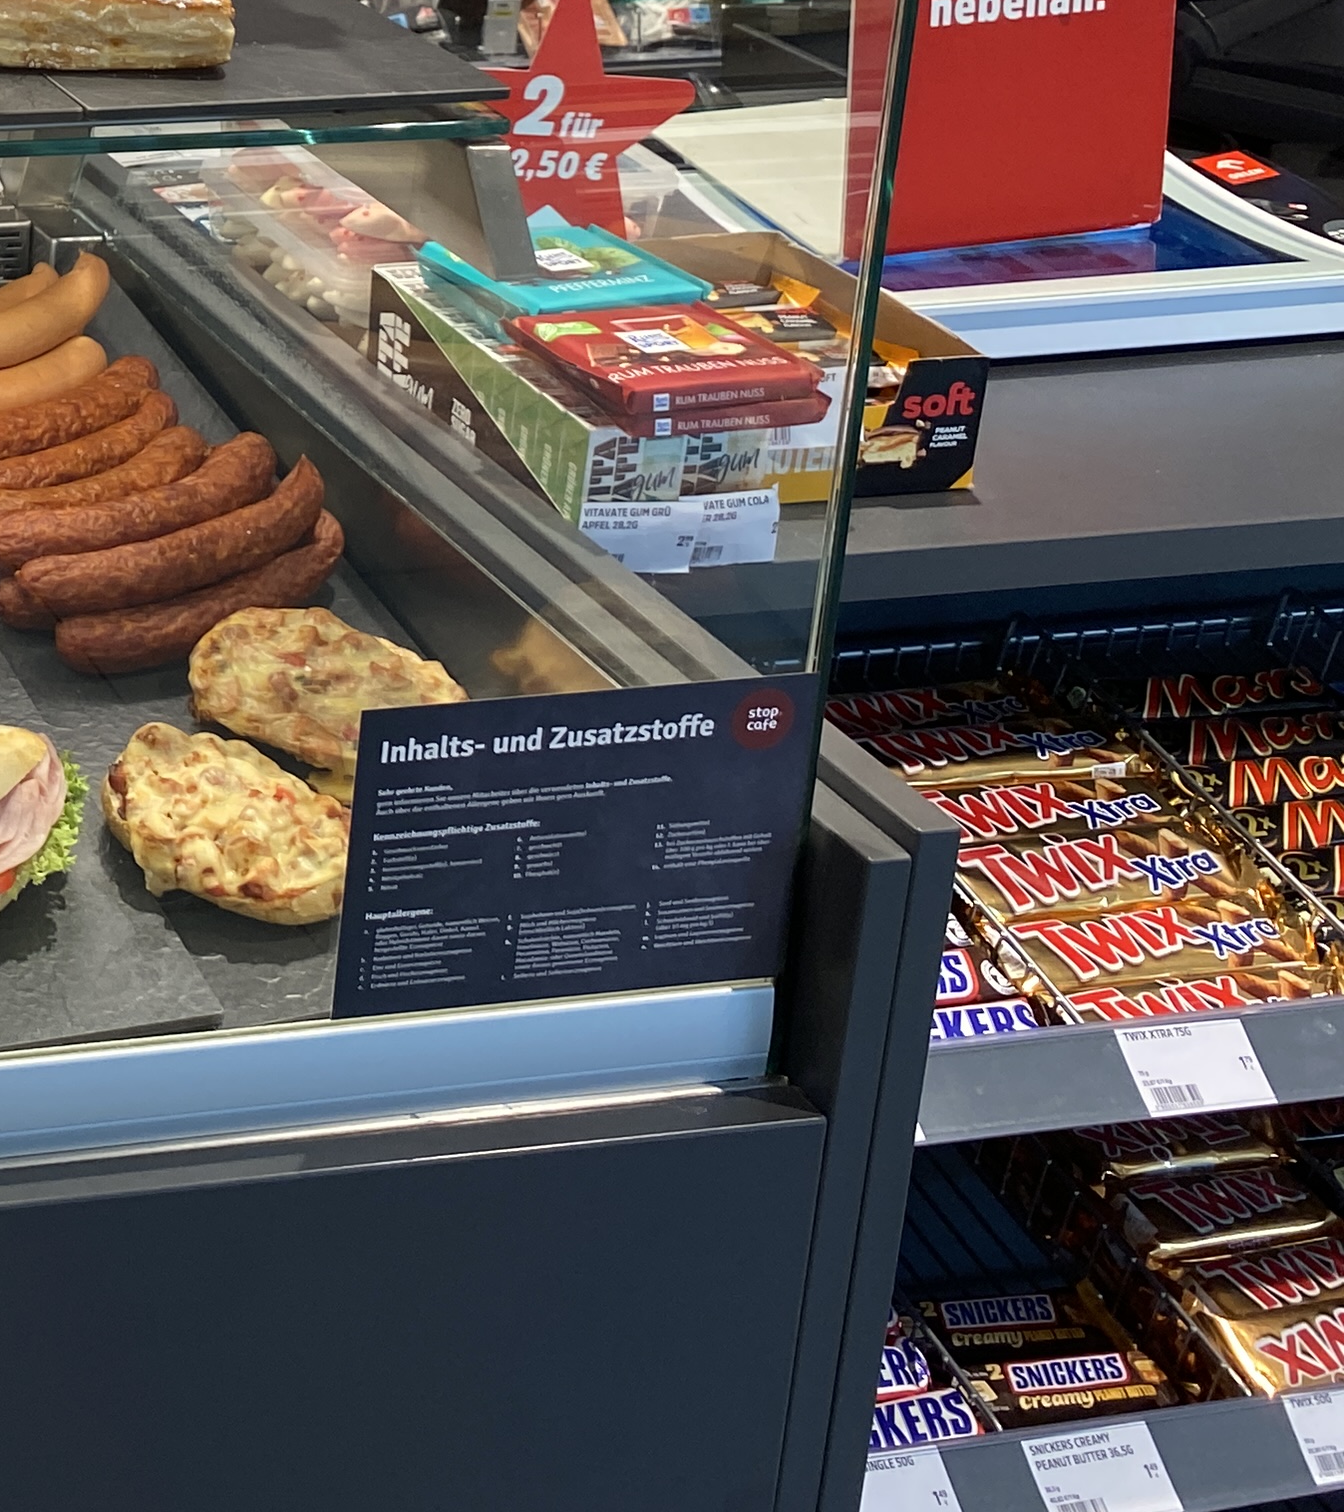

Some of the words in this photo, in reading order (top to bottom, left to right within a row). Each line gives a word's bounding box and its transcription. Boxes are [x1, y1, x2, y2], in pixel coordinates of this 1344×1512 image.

[514, 75, 564, 136] 2
[559, 110, 604, 140] für
[511, 149, 579, 182] 2,50
[583, 150, 608, 182] €
[607, 367, 652, 385] RUM
[654, 359, 735, 377] TRAUBEN
[738, 356, 788, 367] NUSS
[675, 395, 697, 406] RUM
[697, 390, 739, 403] TRAUBEN
[739, 387, 765, 399] NUSS
[902, 382, 975, 419] soft
[678, 420, 699, 431] RUM
[700, 417, 742, 429] TRAUBEN
[743, 415, 770, 425] NUSS
[727, 498, 746, 508] GUM
[748, 496, 769, 506] COLA
[582, 521, 610, 529] APFEL
[748, 706, 779, 721] stop
[746, 717, 777, 731] cafe
[380, 736, 486, 764] Inhalts-
[493, 733, 542, 754] und
[549, 714, 715, 749] Zusatzstoffe
[1069, 794, 1162, 829] Xtra
[957, 833, 1140, 913] TWIX
[1130, 850, 1223, 894] Xtra
[1015, 907, 1208, 980] TWIX
[1197, 917, 1280, 958] Xtra
[1124, 1029, 1149, 1041] TWIX
[1150, 1028, 1172, 1039] XTRA
[946, 1297, 1053, 1325] SNICKERS
[952, 1329, 1022, 1347] creamy
[986, 1365, 1002, 1379] 2
[1014, 1359, 1123, 1389] SNICKERS
[1019, 1391, 1095, 1410] creamy
[1029, 1439, 1073, 1455] SNICKERS
[1074, 1434, 1109, 1448] CREAMY
[895, 1456, 914, 1467] 50G
[1036, 1458, 1073, 1471] PEANUT
[1074, 1452, 1108, 1466] BUTTER
